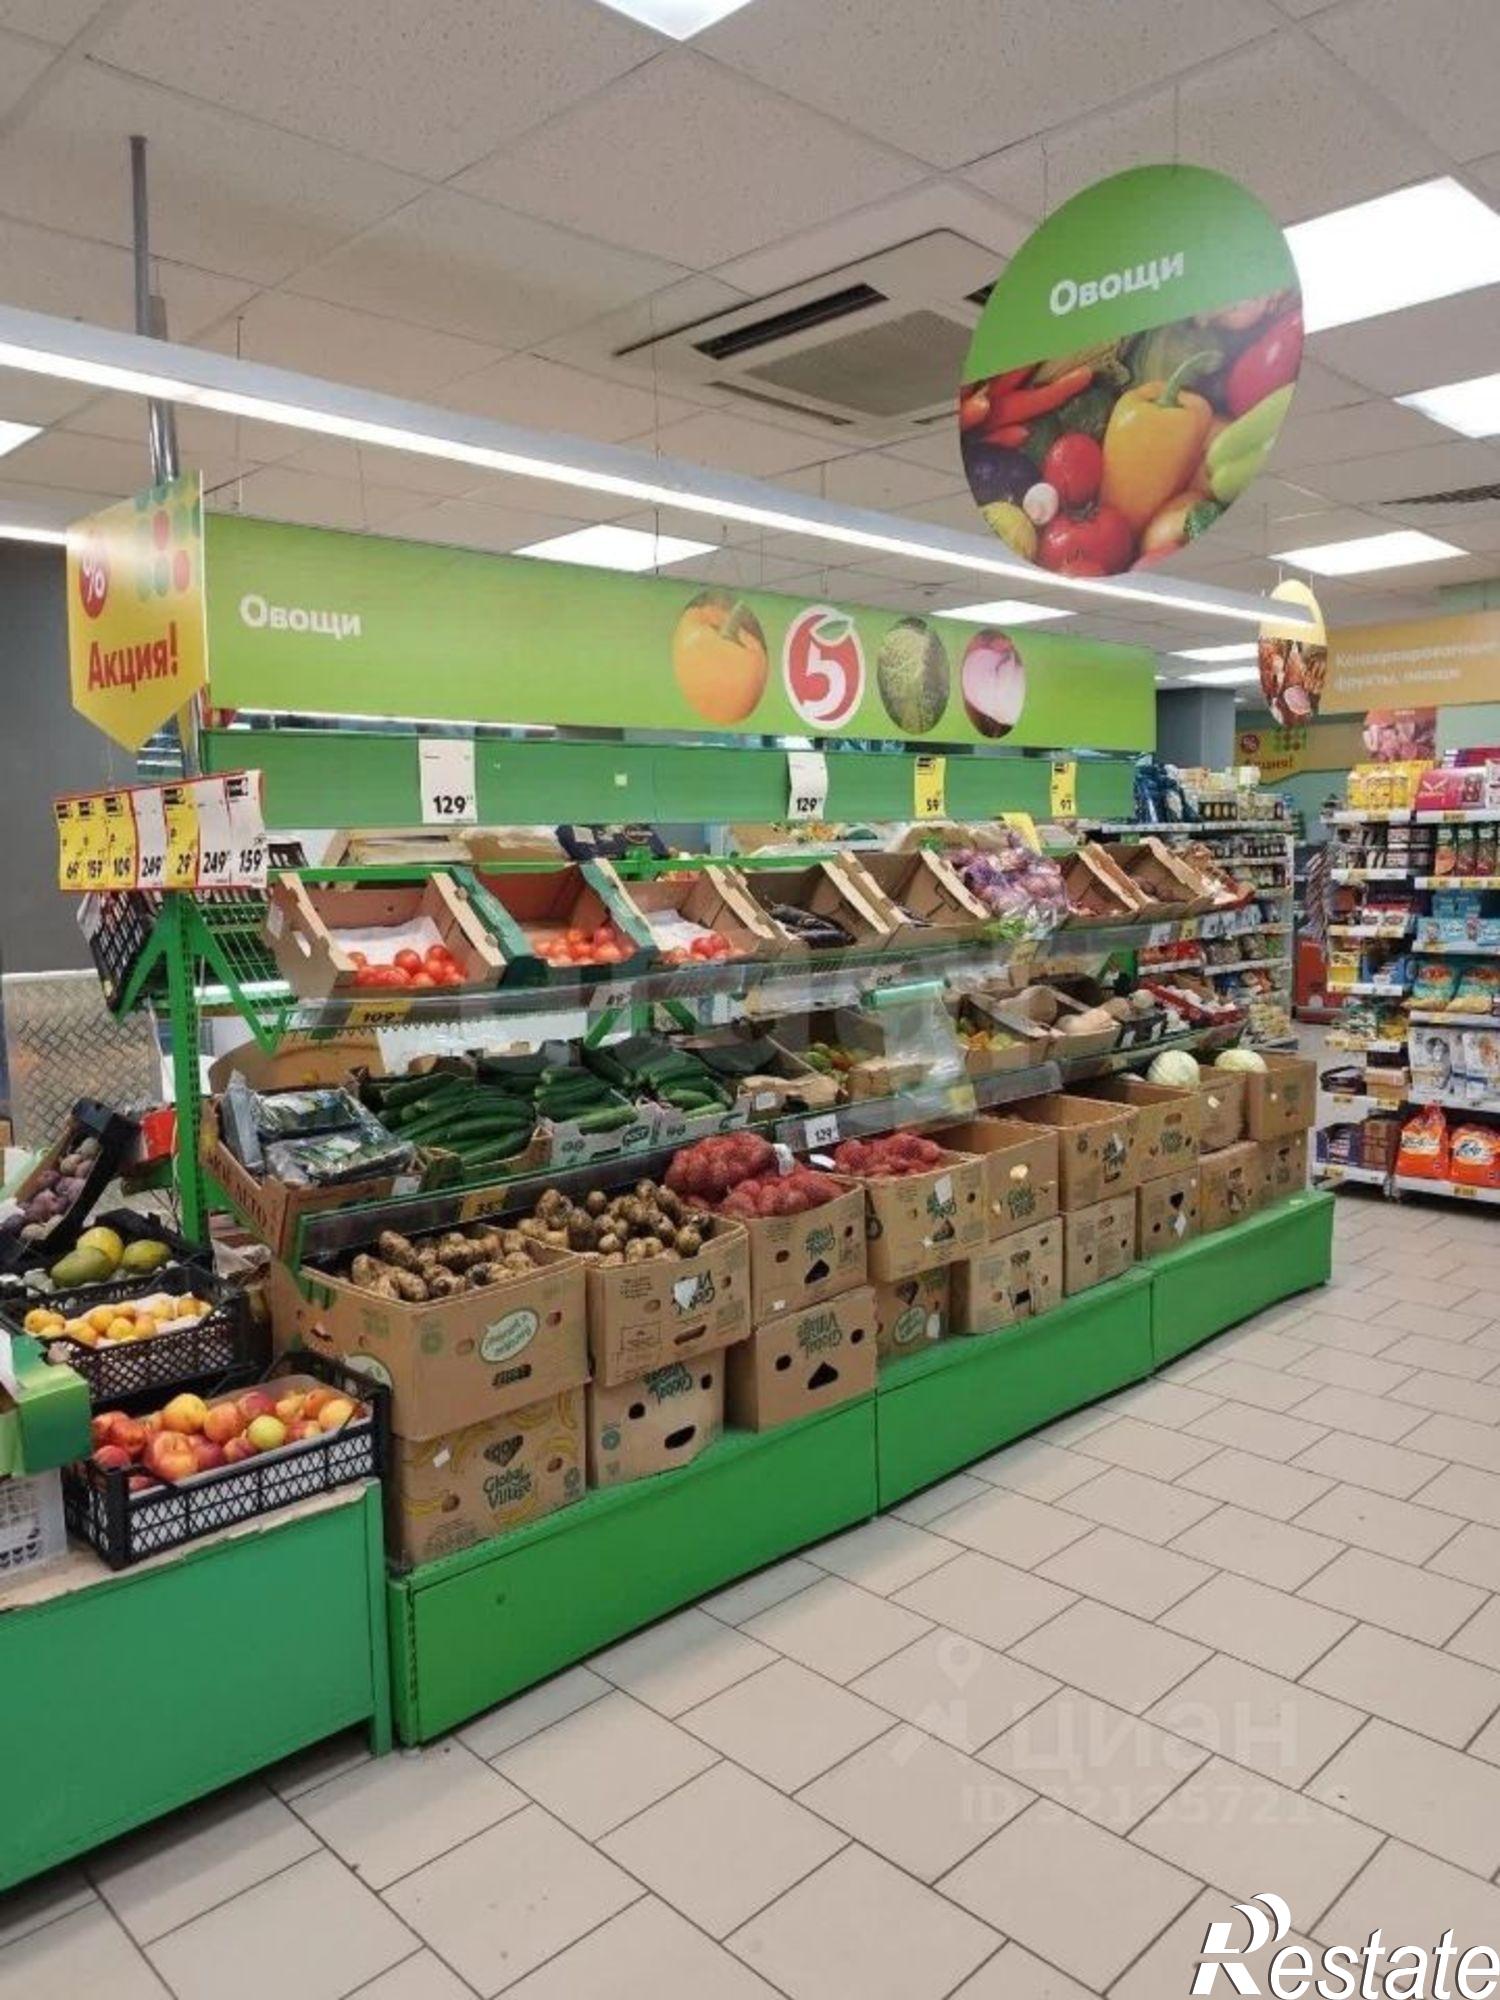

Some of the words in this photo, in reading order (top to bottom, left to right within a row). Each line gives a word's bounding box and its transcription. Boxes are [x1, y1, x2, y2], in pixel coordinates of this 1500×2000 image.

[1050, 251, 1185, 316] Овощи
[239, 594, 362, 640] Овощи
[88, 620, 179, 692] Акция!
[433, 794, 466, 815] 129
[797, 797, 818, 813] 129
[203, 851, 227, 873] 249
[239, 849, 263, 874] 159
[483, 1462, 532, 1493] Global
